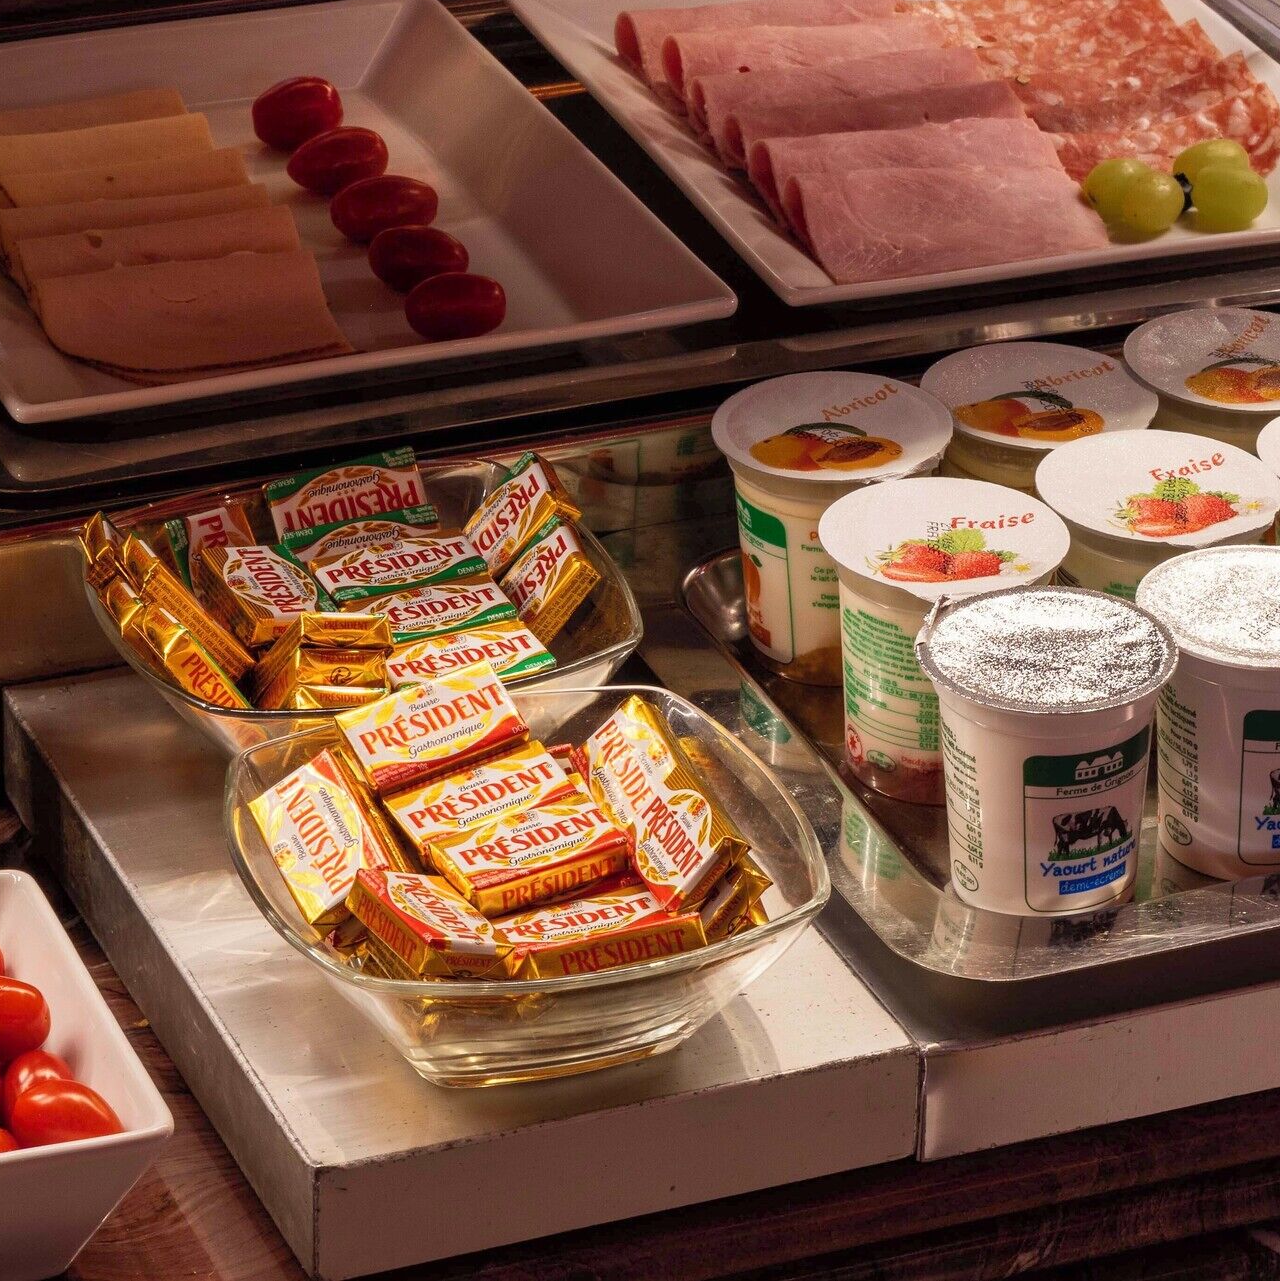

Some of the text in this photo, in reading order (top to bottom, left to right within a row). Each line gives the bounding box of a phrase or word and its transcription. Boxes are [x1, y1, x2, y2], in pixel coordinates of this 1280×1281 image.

[1033, 359, 1115, 390] Abricot
[821, 382, 899, 422] Abricot
[308, 469, 381, 498] Gastronomique
[1148, 451, 1226, 482] Fraise
[472, 473, 541, 556] PRÉSID
[949, 511, 1035, 530] Fraise
[325, 540, 469, 585] PRÉSIDENT
[387, 587, 495, 624] ÉSIDENT
[388, 634, 533, 678] PRÉSIDENT
[180, 651, 239, 709] PRÉSID
[358, 682, 505, 756] PRÉSIDENT
[408, 696, 441, 713] Beurre
[408, 720, 485, 760] Gastronomique
[457, 777, 490, 793] Beurre
[595, 719, 653, 814] PRÉSIDE
[407, 761, 550, 830] PRÉSIDENT
[1055, 785, 1089, 797] Ferme
[1090, 782, 1103, 793] de
[457, 792, 536, 830] Gastronomique
[275, 775, 356, 897] PRÉSIDENT
[460, 807, 608, 866] PRÉSIDENT
[508, 835, 589, 868] Gastronomique
[641, 796, 704, 878] PRÉSIDENT
[500, 854, 618, 912] PRÉSIDENT
[1039, 857, 1098, 878] Yaourt
[496, 896, 652, 939] PRÉSIDENT
[560, 927, 687, 974] PRÉSIDENT
